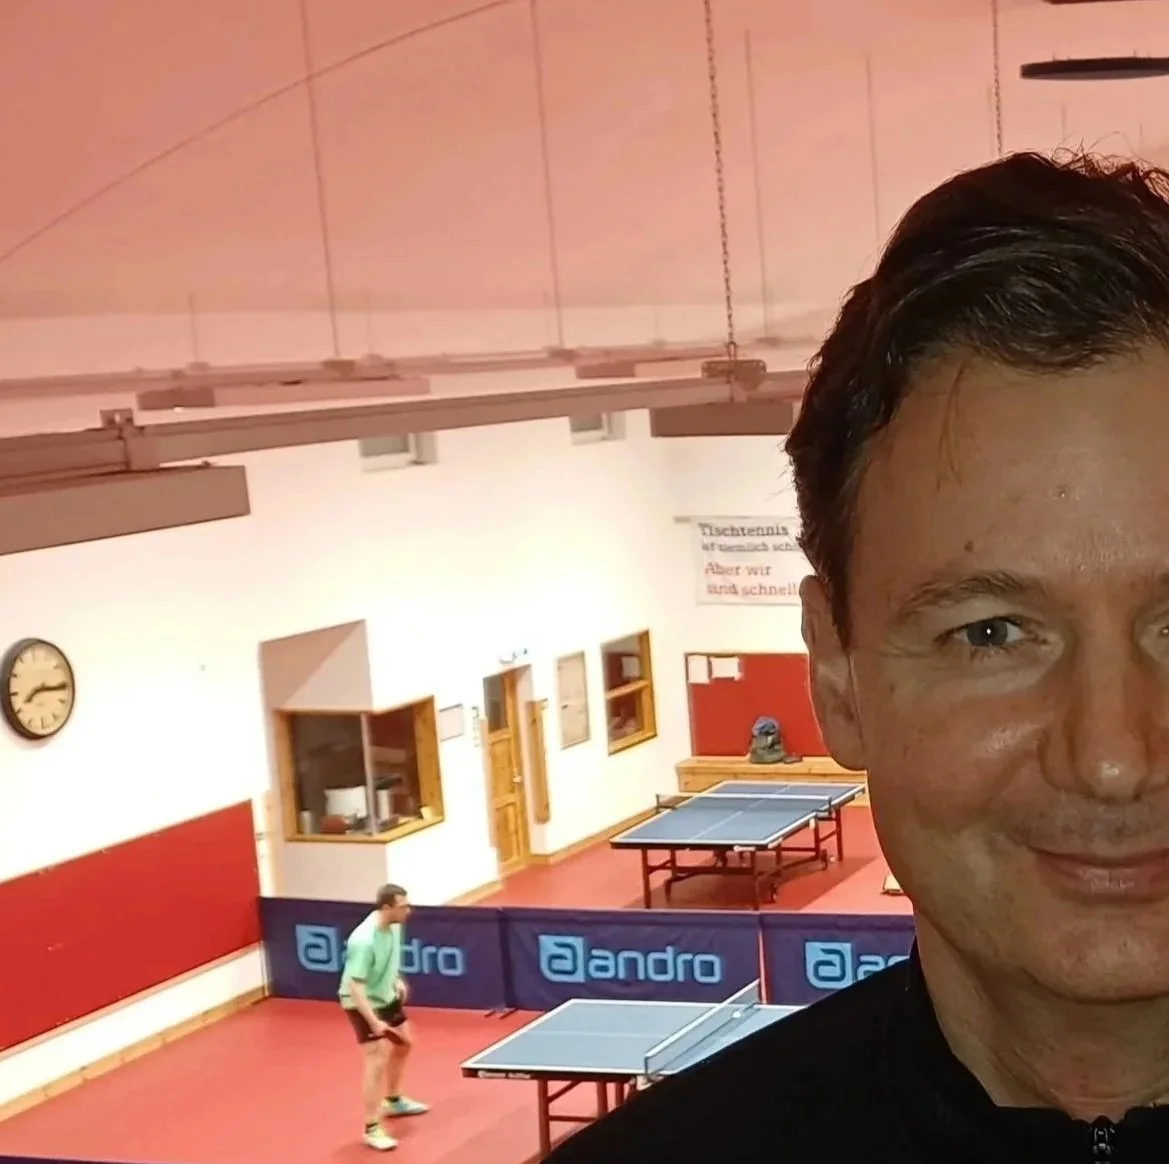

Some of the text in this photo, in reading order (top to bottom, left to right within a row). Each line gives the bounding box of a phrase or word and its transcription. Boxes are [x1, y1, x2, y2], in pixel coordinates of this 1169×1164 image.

[698, 522, 789, 537] Tischtennis
[704, 562, 771, 576] Aber wir
[588, 946, 723, 984] andro
